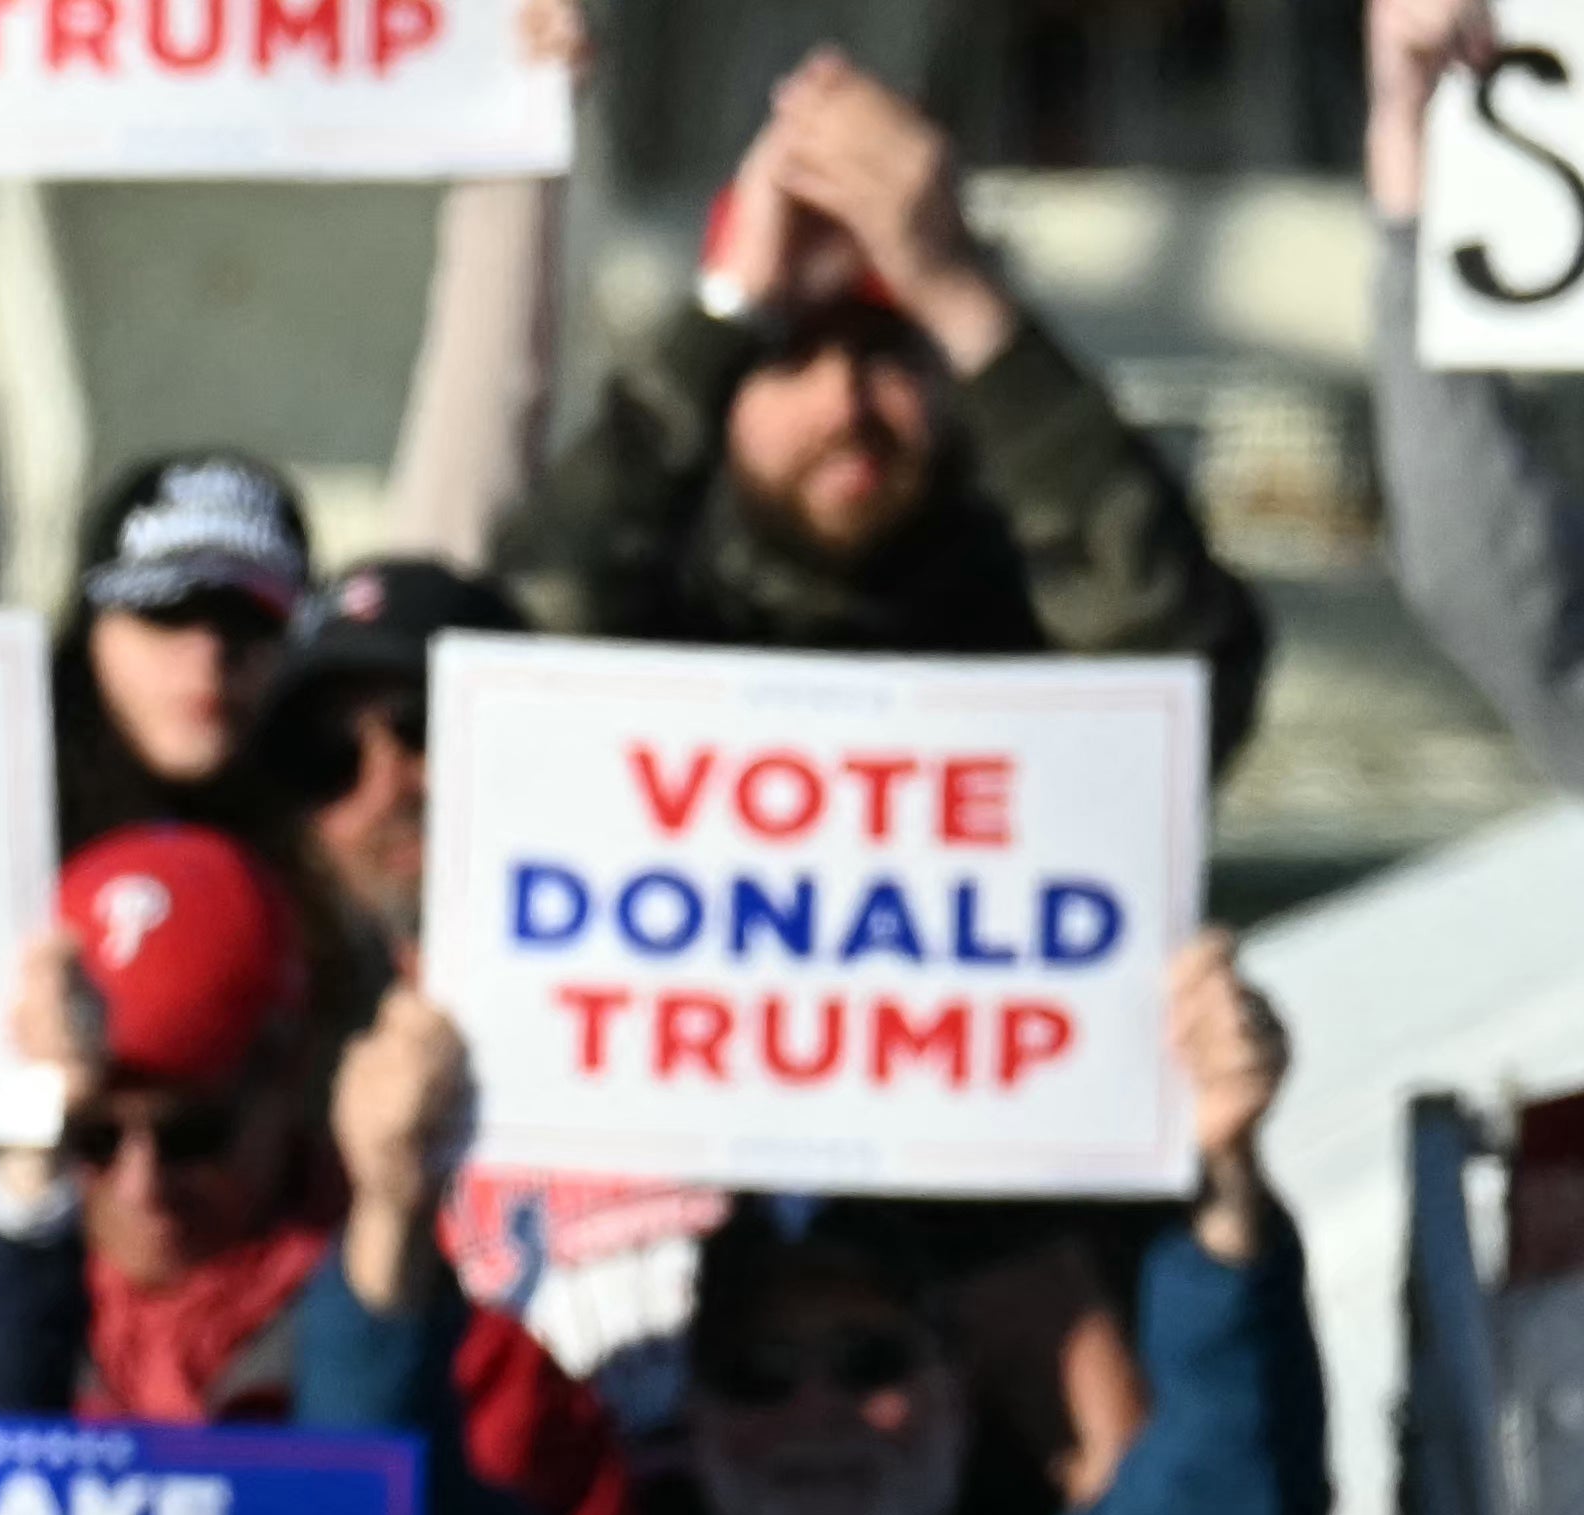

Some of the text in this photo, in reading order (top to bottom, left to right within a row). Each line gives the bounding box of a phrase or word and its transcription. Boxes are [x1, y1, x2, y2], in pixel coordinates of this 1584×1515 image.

[627, 743, 1015, 848] VOTE
[506, 858, 1126, 972] DONALD
[556, 985, 1076, 1091] TRUMP
